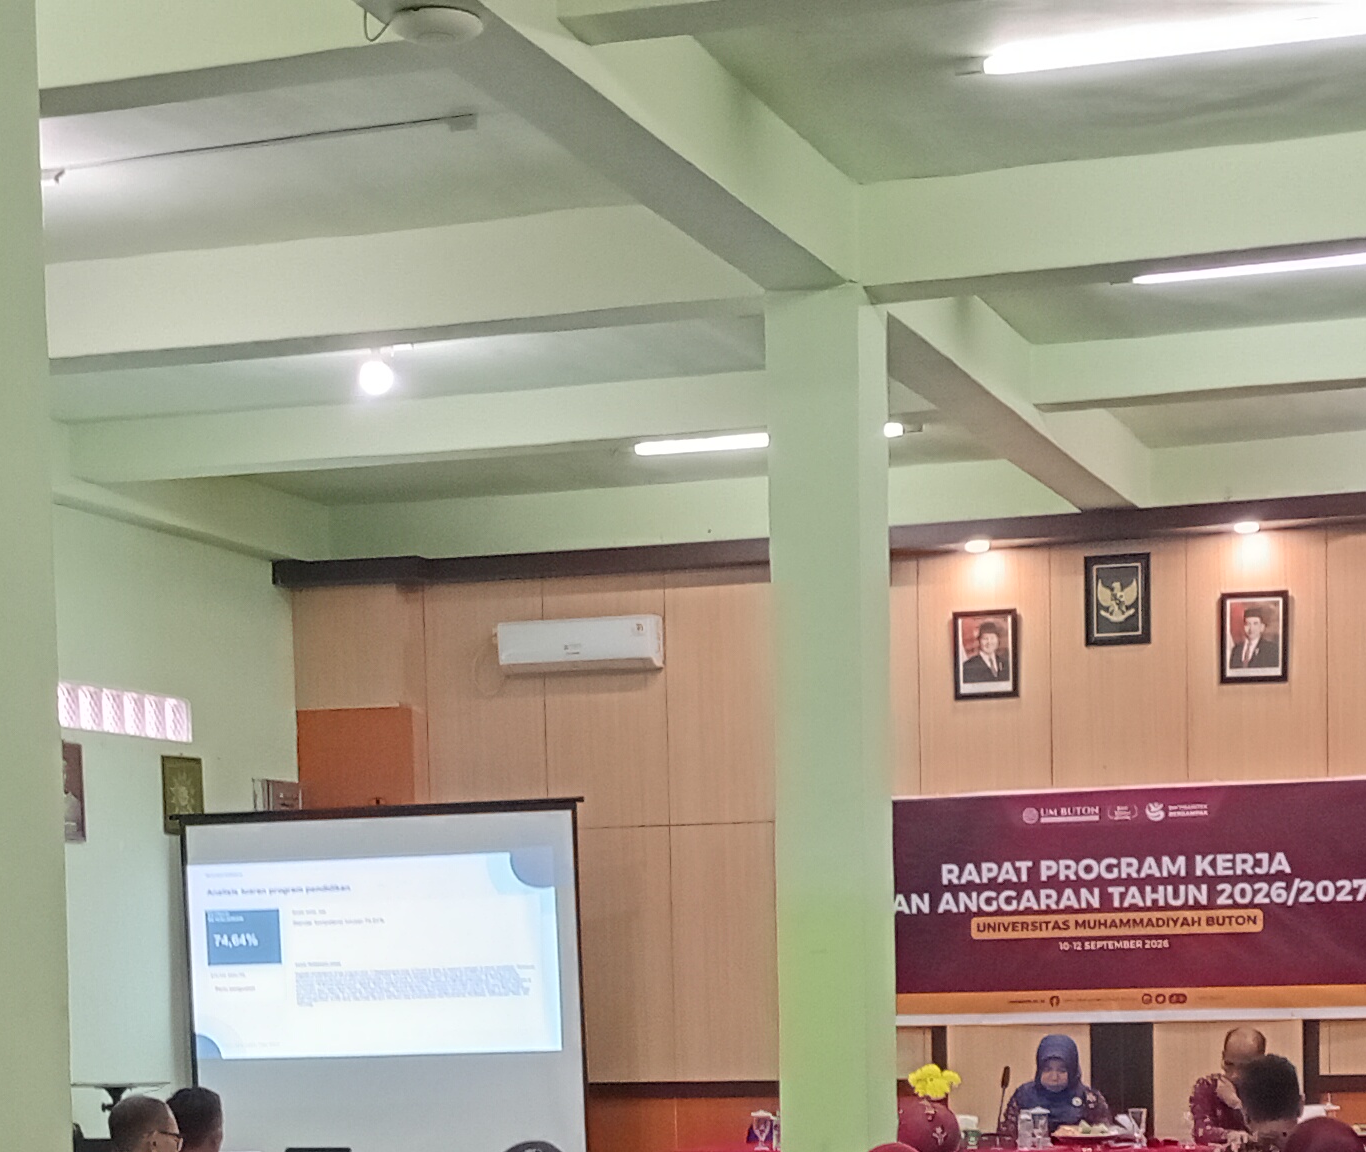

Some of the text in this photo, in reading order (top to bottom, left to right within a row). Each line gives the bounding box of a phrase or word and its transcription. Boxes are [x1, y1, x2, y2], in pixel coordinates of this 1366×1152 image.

[1060, 805, 1100, 816] BUTON
[941, 852, 1292, 885] RAPAT PROGRAM KERJA
[894, 893, 930, 915] AN
[937, 888, 1100, 914] ANGGARAN
[1107, 884, 1208, 908] TAHUN
[976, 914, 1258, 933] UNIVERSITAS MUHAMMADIYAH BUTON
[1084, 939, 1143, 951] SEPTEMBER
